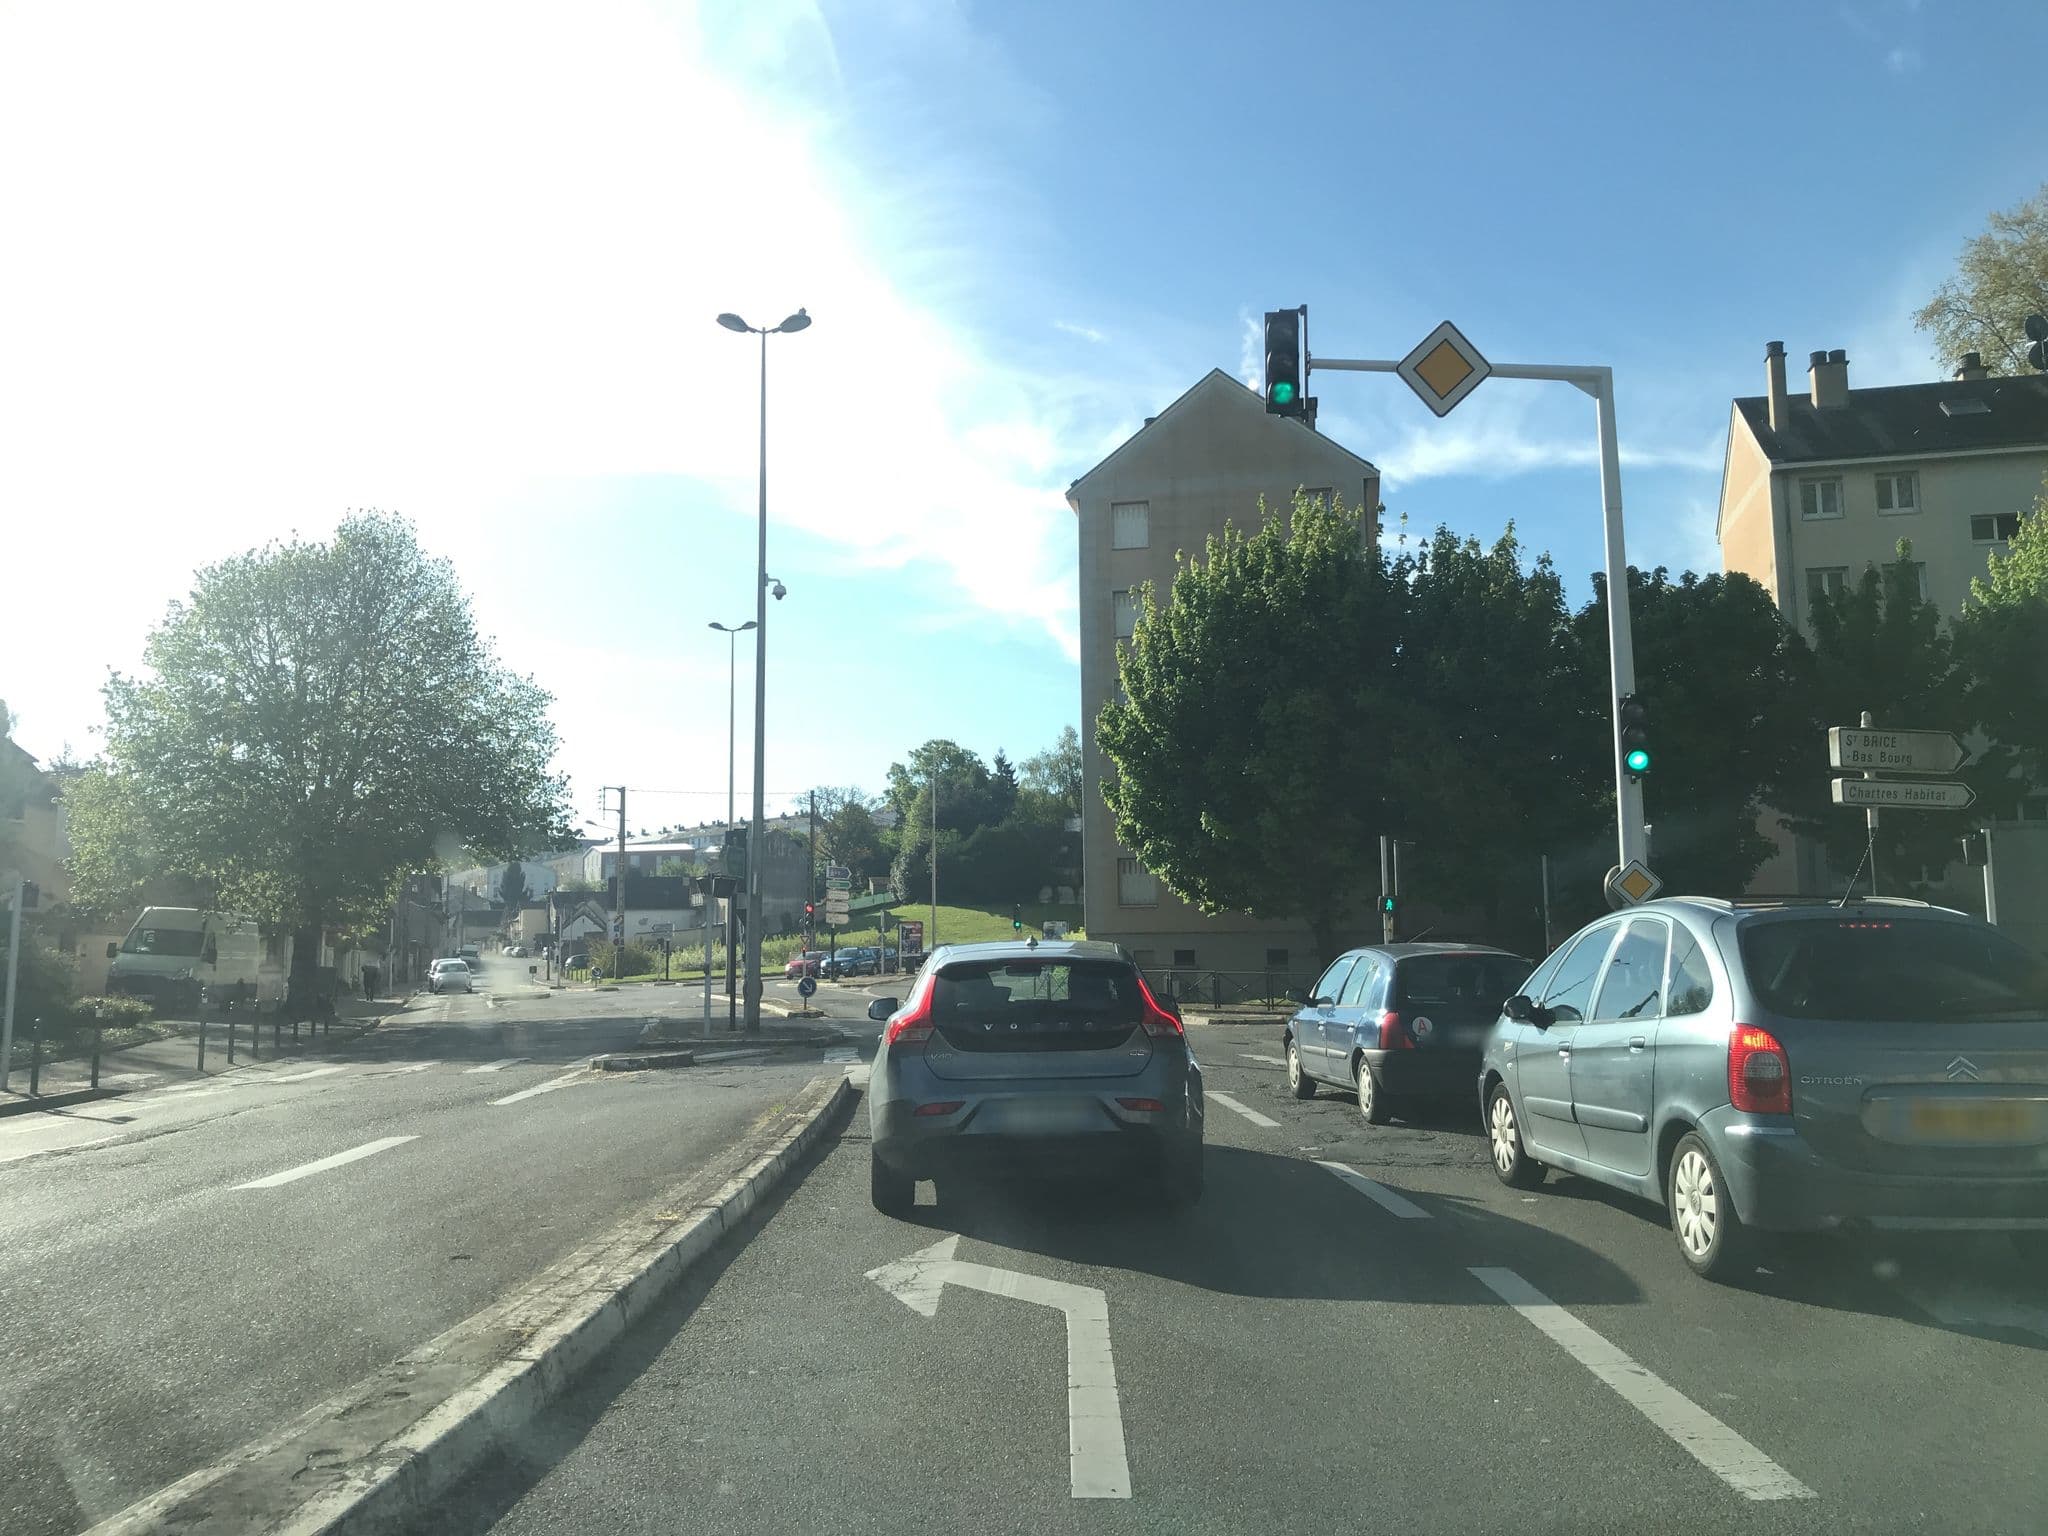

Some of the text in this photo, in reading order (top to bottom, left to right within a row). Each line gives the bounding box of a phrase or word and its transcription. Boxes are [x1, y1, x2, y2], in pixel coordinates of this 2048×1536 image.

[1863, 735, 1897, 748] BRICE
[1880, 752, 1913, 765] Bourg
[1849, 786, 1946, 801] Chartres Habitat
[1417, 1018, 1428, 1034] A
